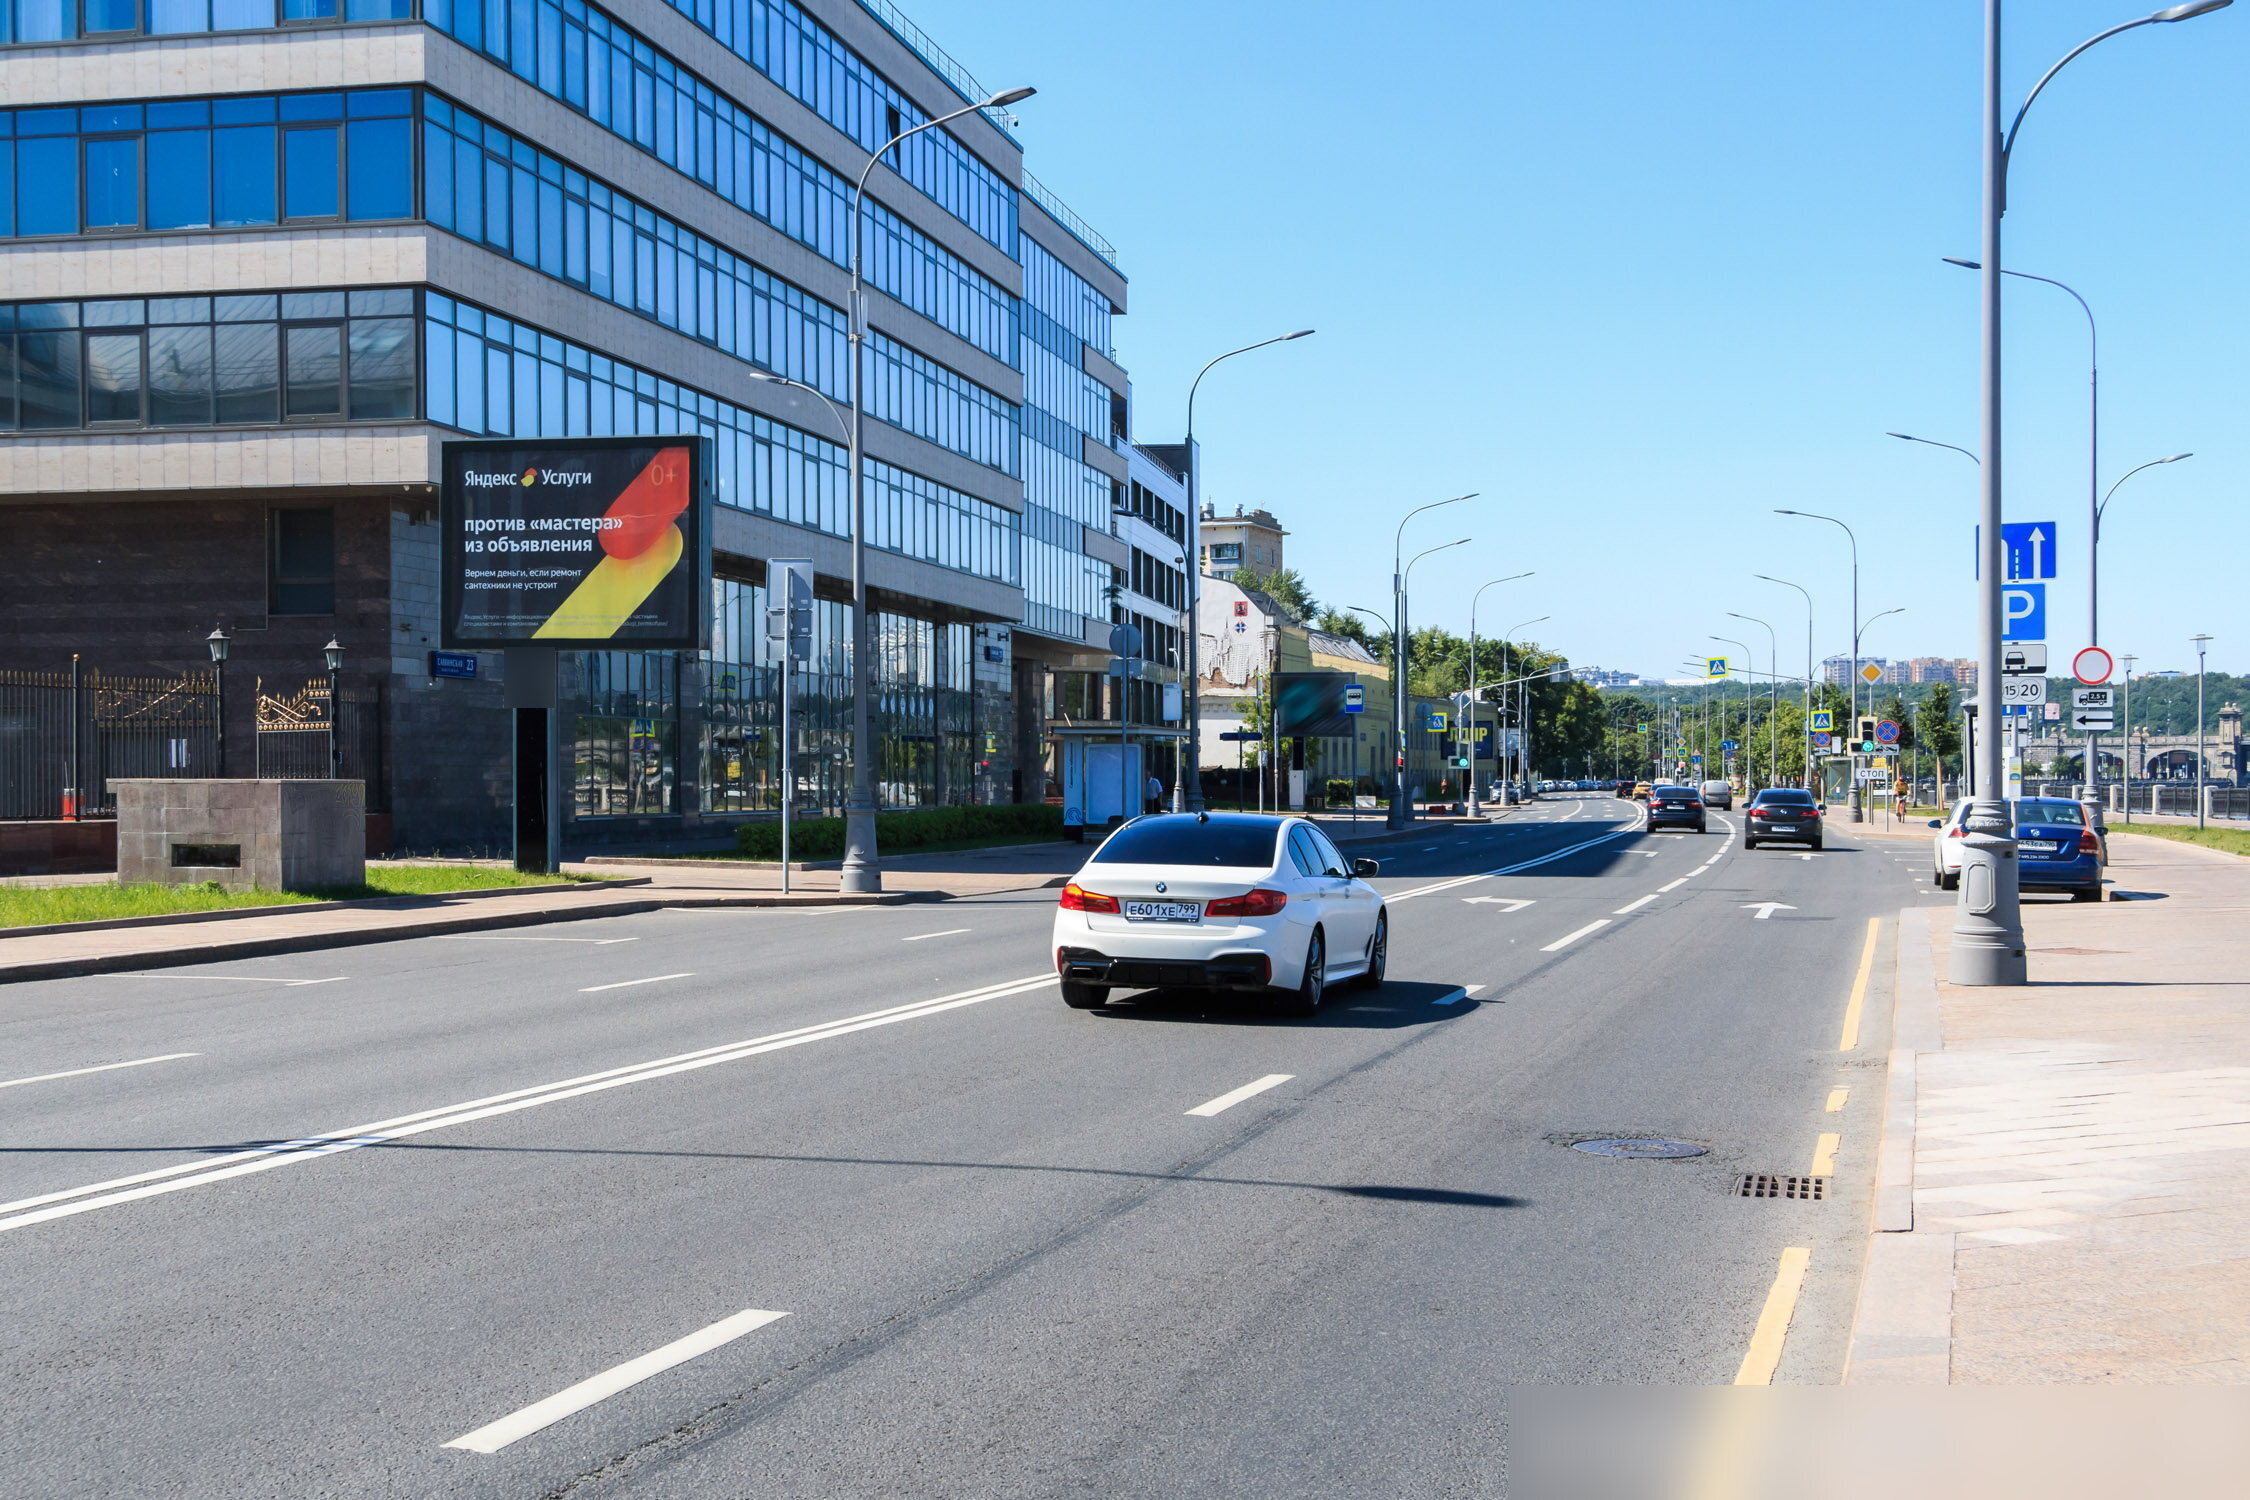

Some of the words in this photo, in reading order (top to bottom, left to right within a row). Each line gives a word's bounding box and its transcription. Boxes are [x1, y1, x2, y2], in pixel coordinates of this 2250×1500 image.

[464, 470, 517, 488] Яндекс
[541, 468, 592, 487] Услуги
[651, 464, 677, 486] 0+
[464, 518, 526, 535] против
[530, 516, 623, 533] «мастера»
[464, 539, 484, 553] из
[487, 537, 593, 553] объявления
[464, 569, 496, 578] Вернем
[497, 569, 528, 579] деньги,
[529, 568, 550, 578] если
[550, 569, 582, 579] ремонт
[464, 582, 511, 590] сантехники
[512, 581, 523, 589] не
[524, 581, 558, 591] устроит
[2003, 590, 2034, 635] P
[466, 659, 474, 671] 23
[2004, 685, 2016, 696] 15
[2020, 683, 2039, 697] 20
[1860, 770, 1884, 778] СТОП
[1130, 904, 1176, 917] Е601ХЕ
[1178, 904, 1196, 914] 799
